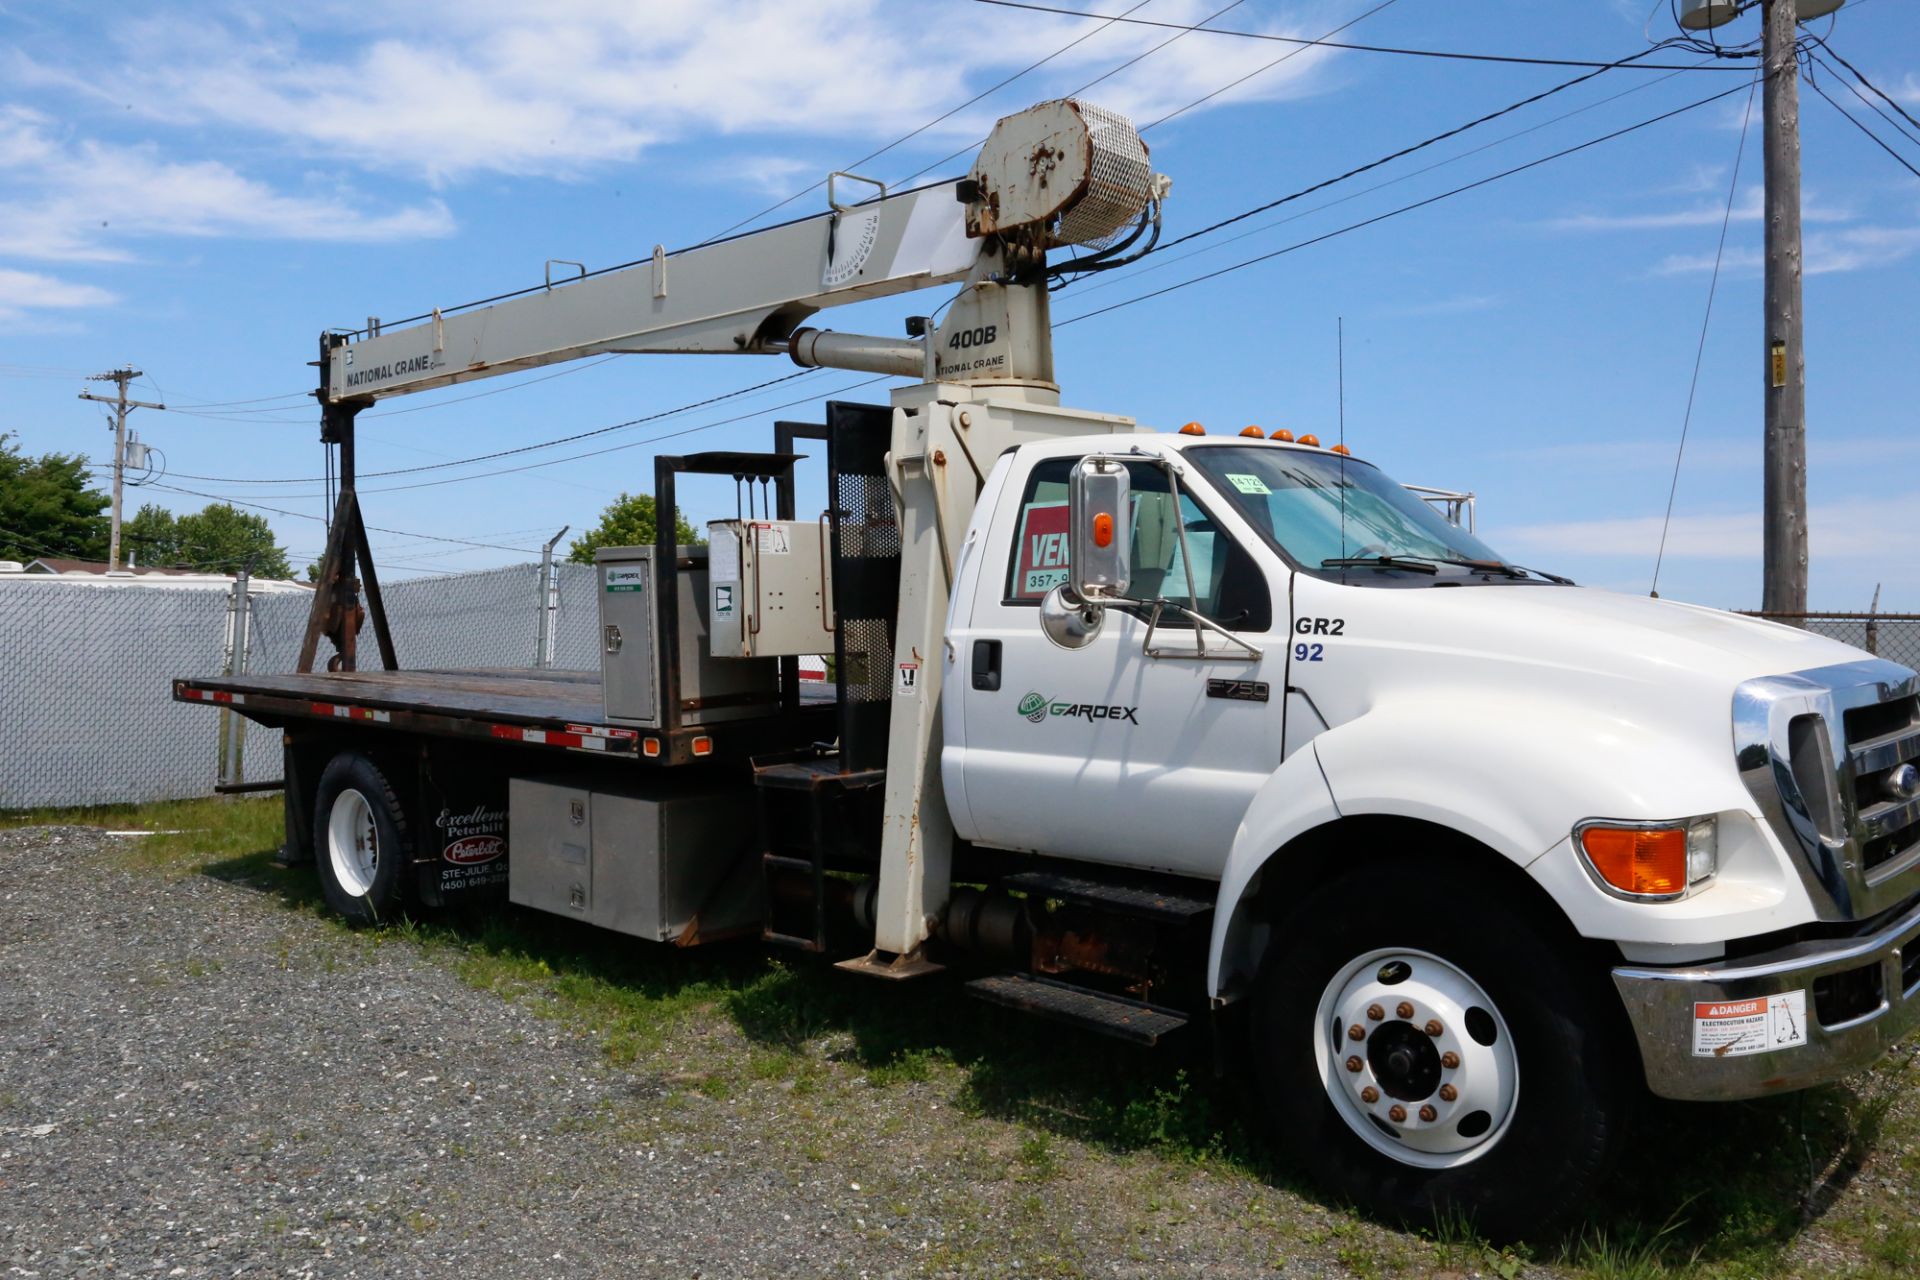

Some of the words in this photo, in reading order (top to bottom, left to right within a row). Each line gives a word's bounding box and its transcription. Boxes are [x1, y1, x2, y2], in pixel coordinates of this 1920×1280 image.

[949, 325, 997, 350] 400B
[347, 365, 393, 387] NATIONAL
[395, 355, 429, 375] CRANE
[939, 363, 972, 376] TIONAL
[973, 355, 1004, 369] CRANE
[1295, 617, 1345, 636] GR2
[1295, 643, 1323, 661] 92
[1050, 702, 1138, 725] GARDEX
[448, 822, 504, 837] Peterbilt
[452, 841, 503, 860] Peterbilt
[441, 879, 466, 891] (450)
[1719, 1002, 1757, 1015] DANGER
[1702, 1018, 1745, 1027] ELECTROCUTION
[1745, 1016, 1764, 1024] HAZARD
